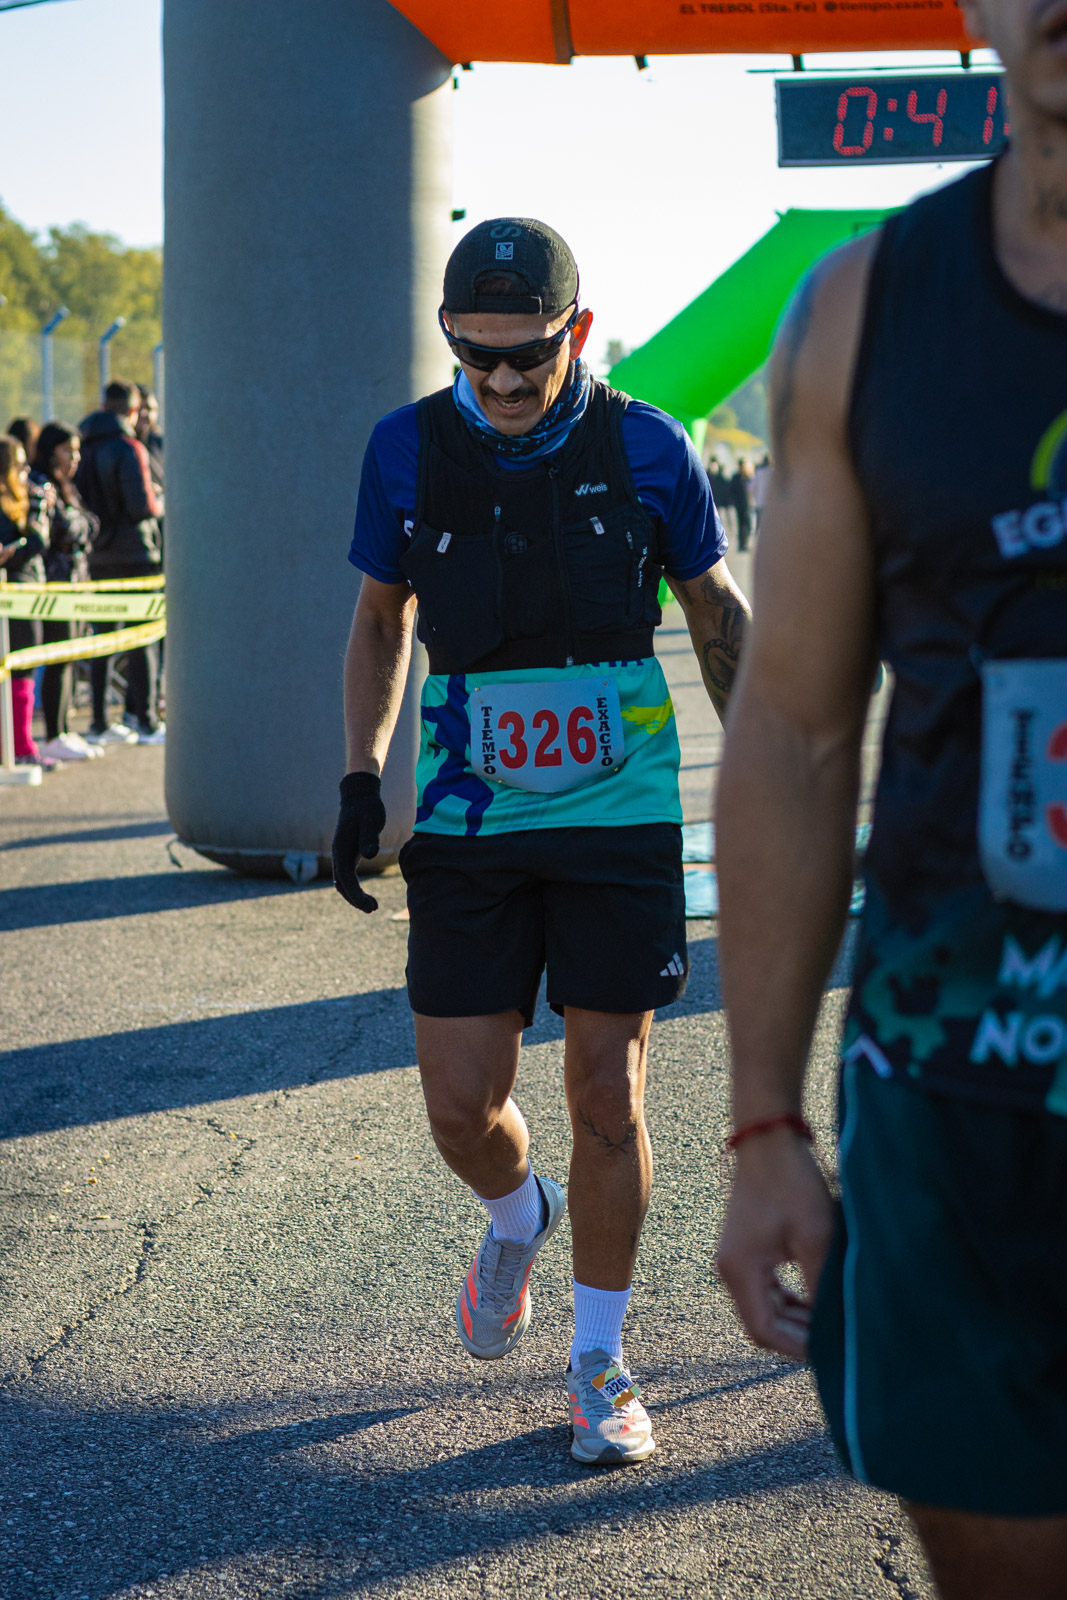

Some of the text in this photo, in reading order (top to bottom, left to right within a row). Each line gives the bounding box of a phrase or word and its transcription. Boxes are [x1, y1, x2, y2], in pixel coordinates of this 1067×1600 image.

[481, 706, 496, 775] TIEMPO
[497, 705, 597, 770] 326
[596, 697, 613, 767] EXACTO
[605, 1378, 628, 1396] 326
